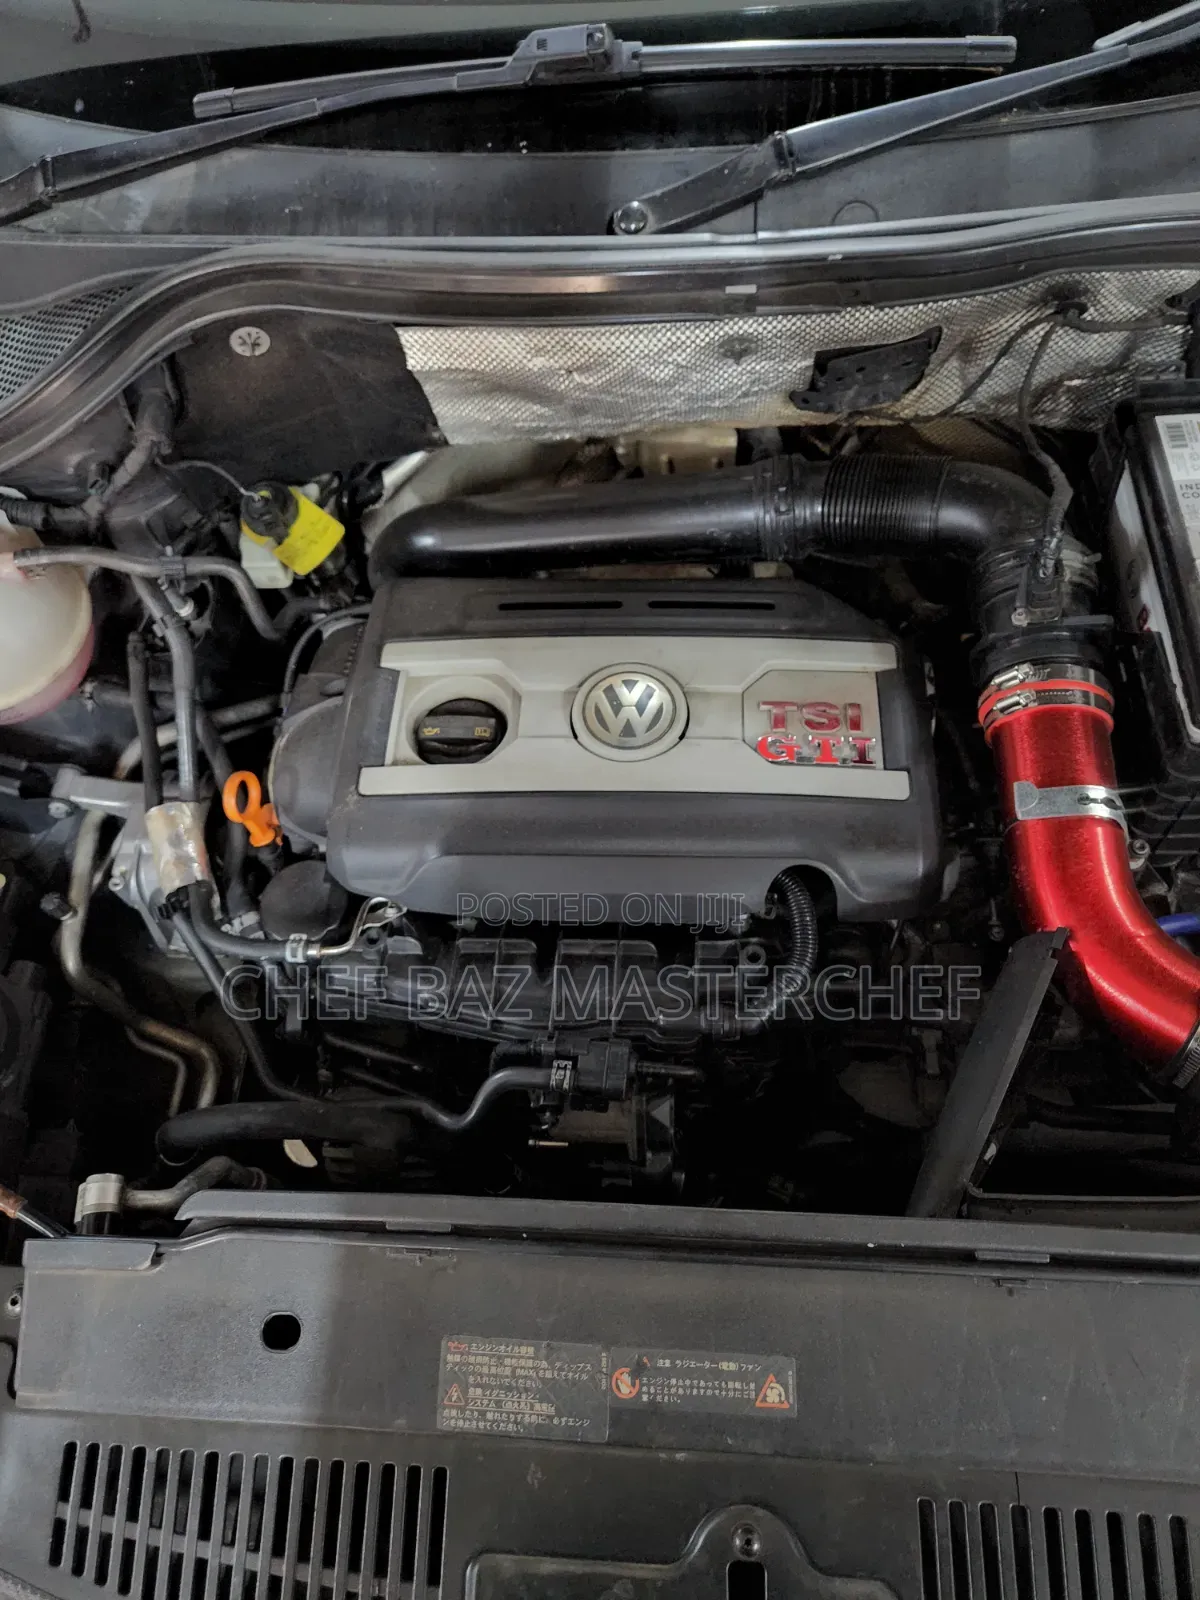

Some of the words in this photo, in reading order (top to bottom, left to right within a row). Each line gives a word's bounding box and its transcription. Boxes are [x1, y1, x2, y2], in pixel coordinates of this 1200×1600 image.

[590, 674, 670, 744] VW
[759, 701, 864, 732] TSI
[756, 735, 876, 765] GTI
